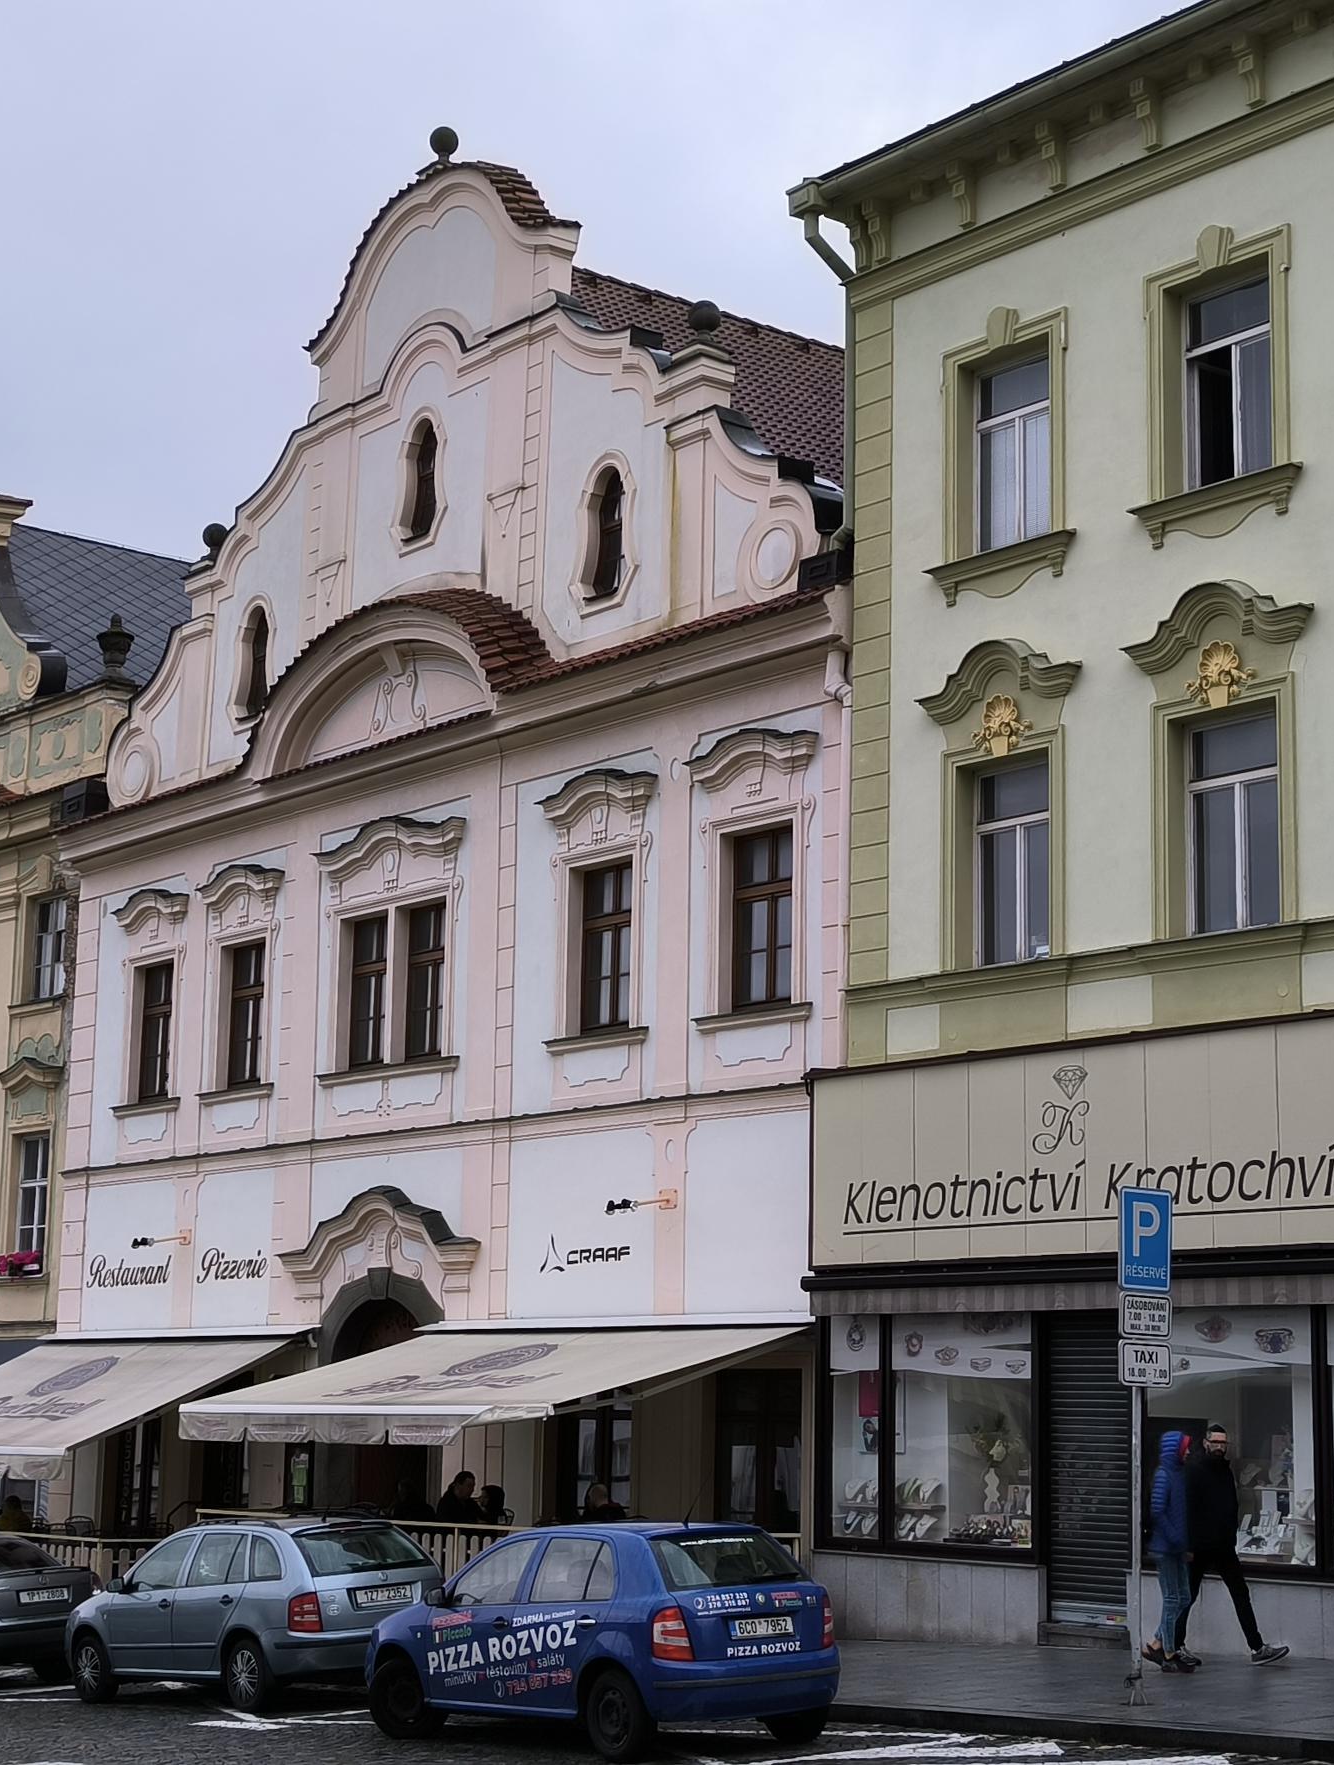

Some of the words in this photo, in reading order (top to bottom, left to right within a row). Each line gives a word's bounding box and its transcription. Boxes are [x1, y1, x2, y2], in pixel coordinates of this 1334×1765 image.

[843, 1159, 1086, 1225] Klenotnictví
[1133, 1201, 1161, 1257] P
[567, 1246, 630, 1265] CRAAF
[86, 1254, 172, 1288] Restaurant
[197, 1247, 269, 1284] Pizzerie
[1126, 1262, 1167, 1281] RÉSERVÉ
[1126, 1298, 1167, 1313] ZÁSOBOVÁNÍ
[1128, 1312, 1142, 1321] 7.00
[1148, 1314, 1167, 1324] 18.00
[1133, 1350, 1159, 1365] TAXI
[1127, 1367, 1147, 1379] 18.00
[1153, 1369, 1168, 1380] 7.00
[364, 1589, 379, 1601] 1Z7
[387, 1586, 408, 1599] 2352
[512, 1612, 544, 1628] ZDARMA
[738, 1620, 758, 1635] 6C0
[765, 1618, 790, 1634] 7952
[427, 1641, 485, 1675] PIZZA
[488, 1620, 577, 1662] ROZVOZ
[727, 1645, 759, 1658] PIZZA
[761, 1641, 801, 1654] ROZVOZ
[444, 1670, 477, 1688] minutky
[486, 1658, 528, 1679] těstoviny
[537, 1652, 565, 1669] saláty
[506, 1678, 528, 1696] 724
